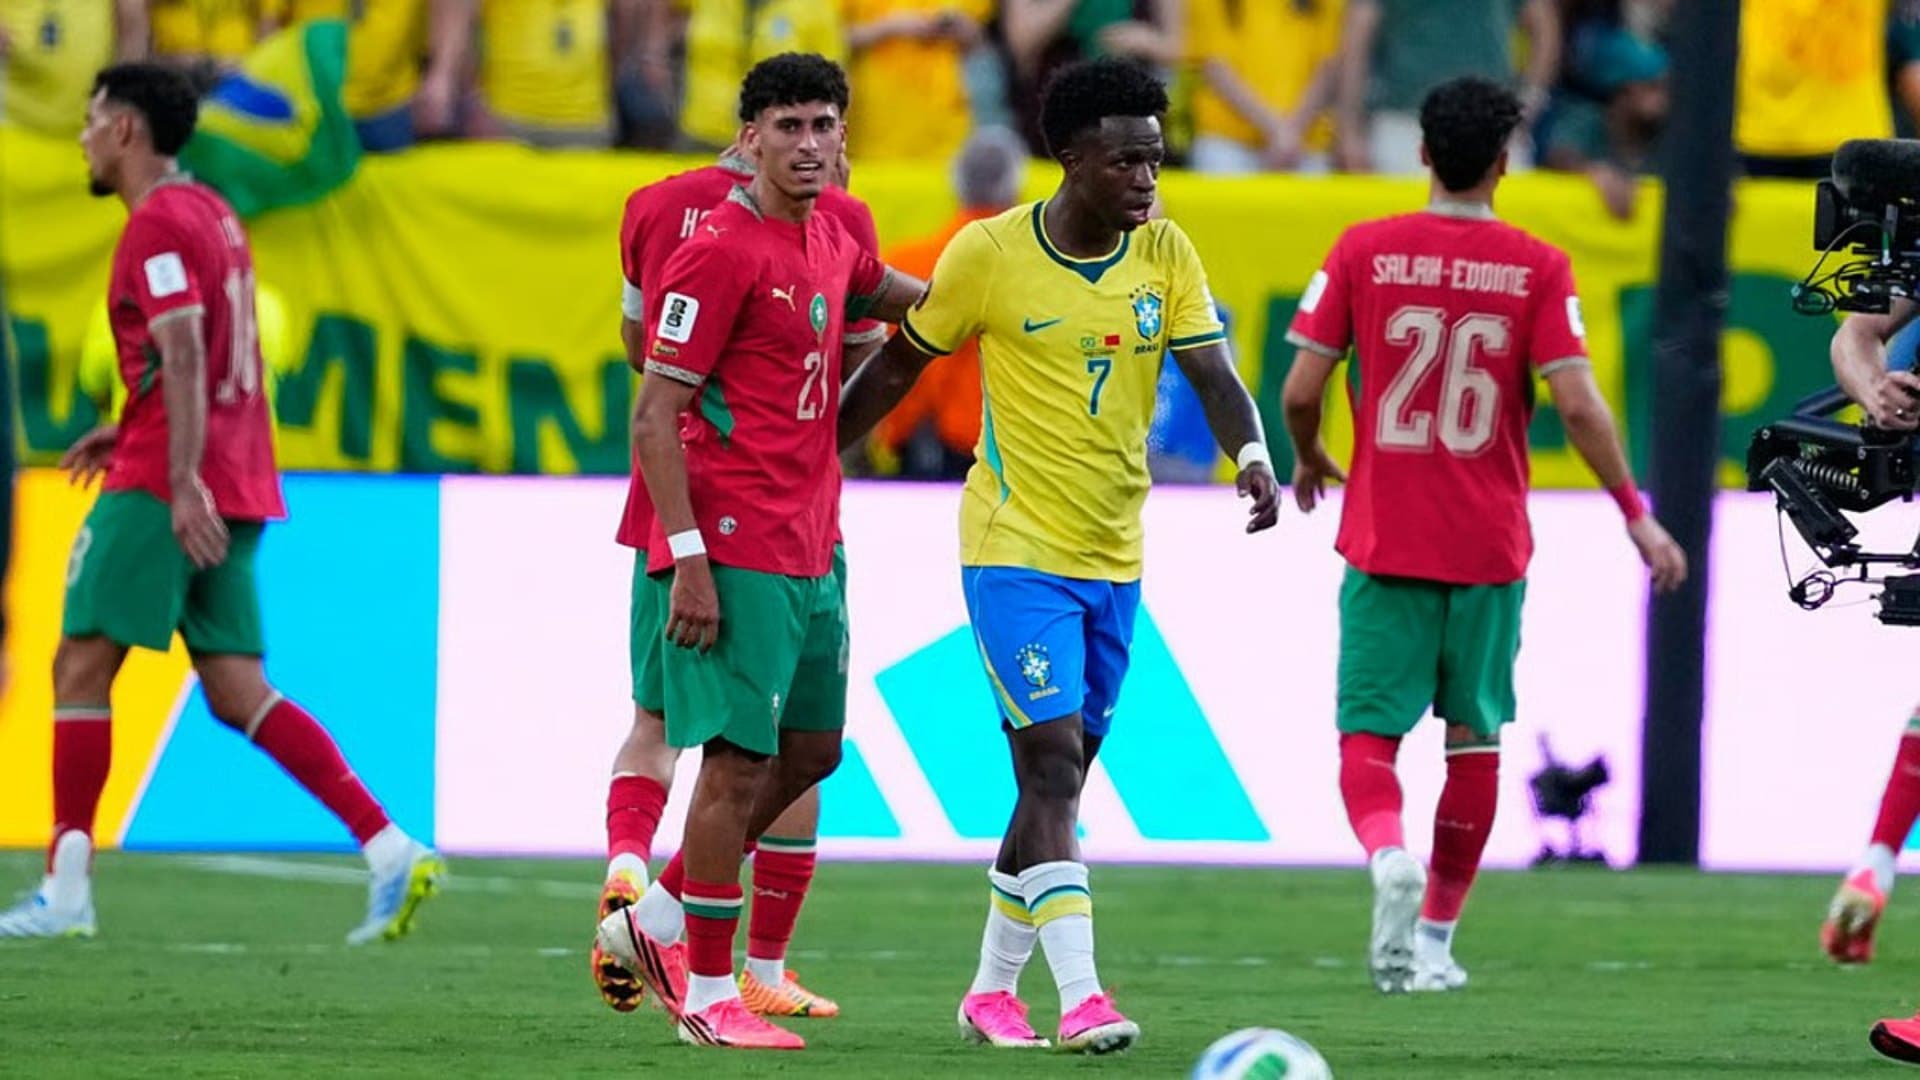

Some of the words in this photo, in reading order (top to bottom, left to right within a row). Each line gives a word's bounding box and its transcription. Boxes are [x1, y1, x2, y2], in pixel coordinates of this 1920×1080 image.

[1372, 254, 1532, 296] SALAH-EDDINE
[796, 350, 829, 420] 21
[1087, 359, 1112, 415] 7
[1375, 305, 1512, 457] 26
